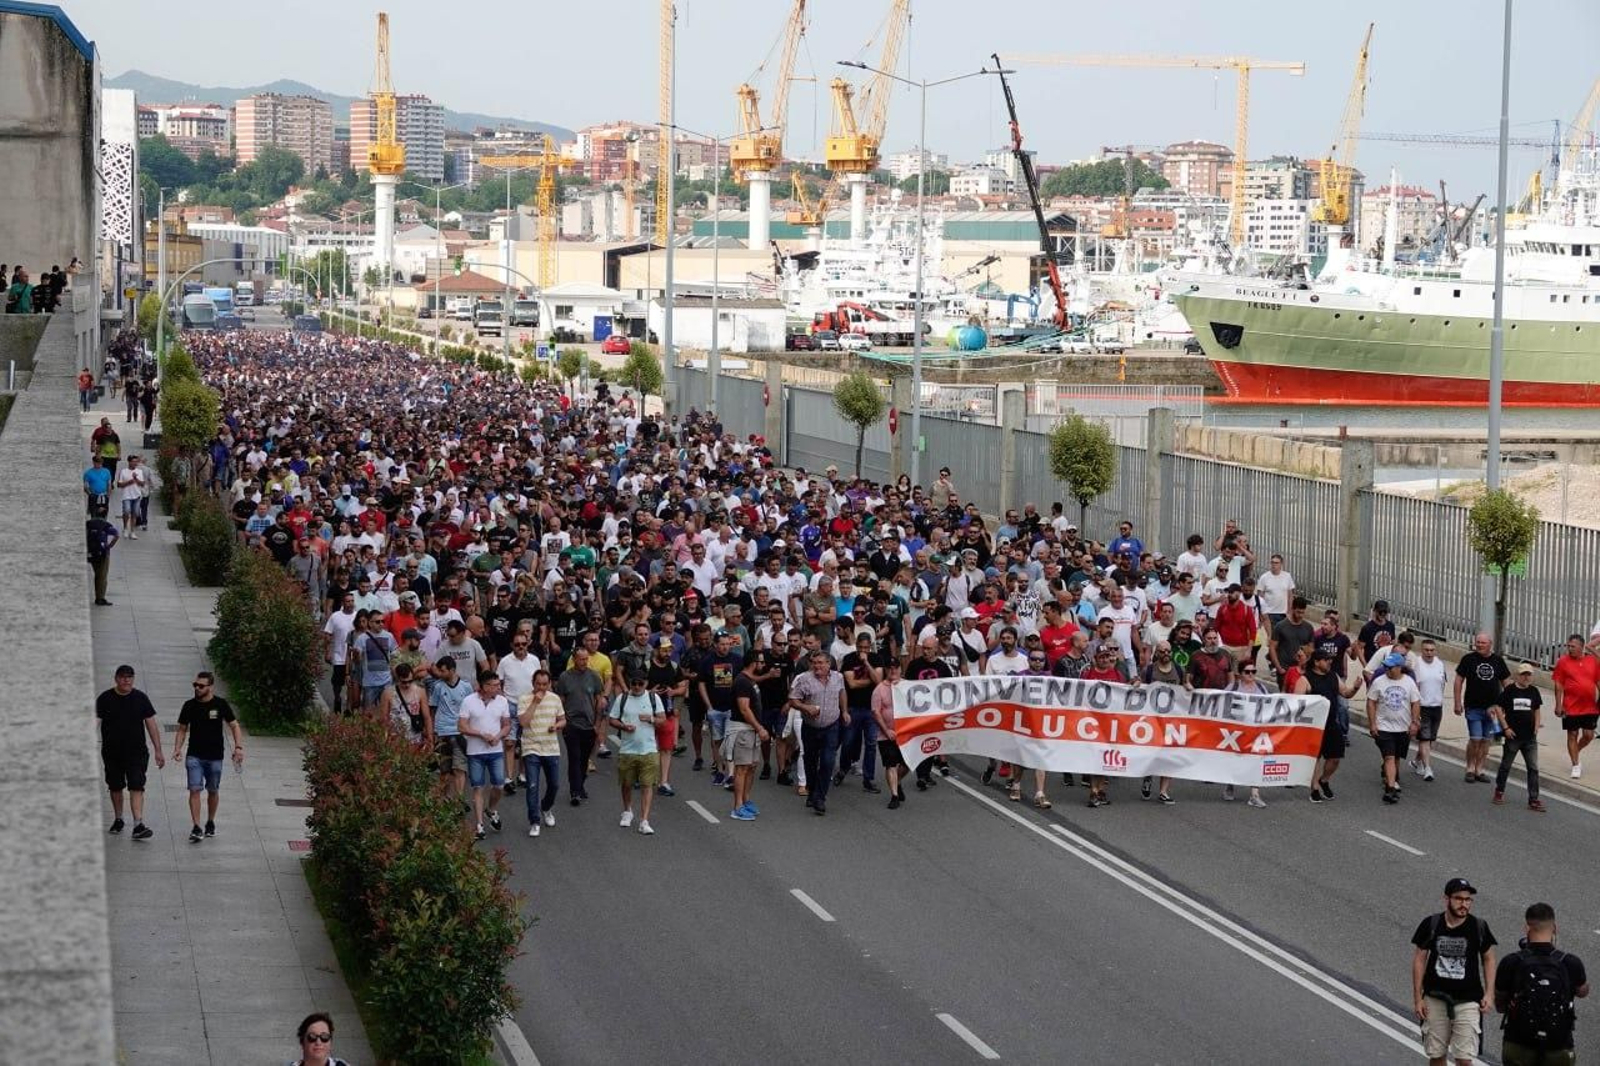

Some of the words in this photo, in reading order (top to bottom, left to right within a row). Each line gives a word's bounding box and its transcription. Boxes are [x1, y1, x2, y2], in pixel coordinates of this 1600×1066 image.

[1235, 288, 1277, 299] BEAGLE
[906, 677, 1112, 713] CONVENIO
[1124, 684, 1176, 714] DO
[1188, 692, 1314, 724] METAL
[943, 707, 1188, 746] SOLUCIÓN
[1216, 727, 1275, 755] XA
